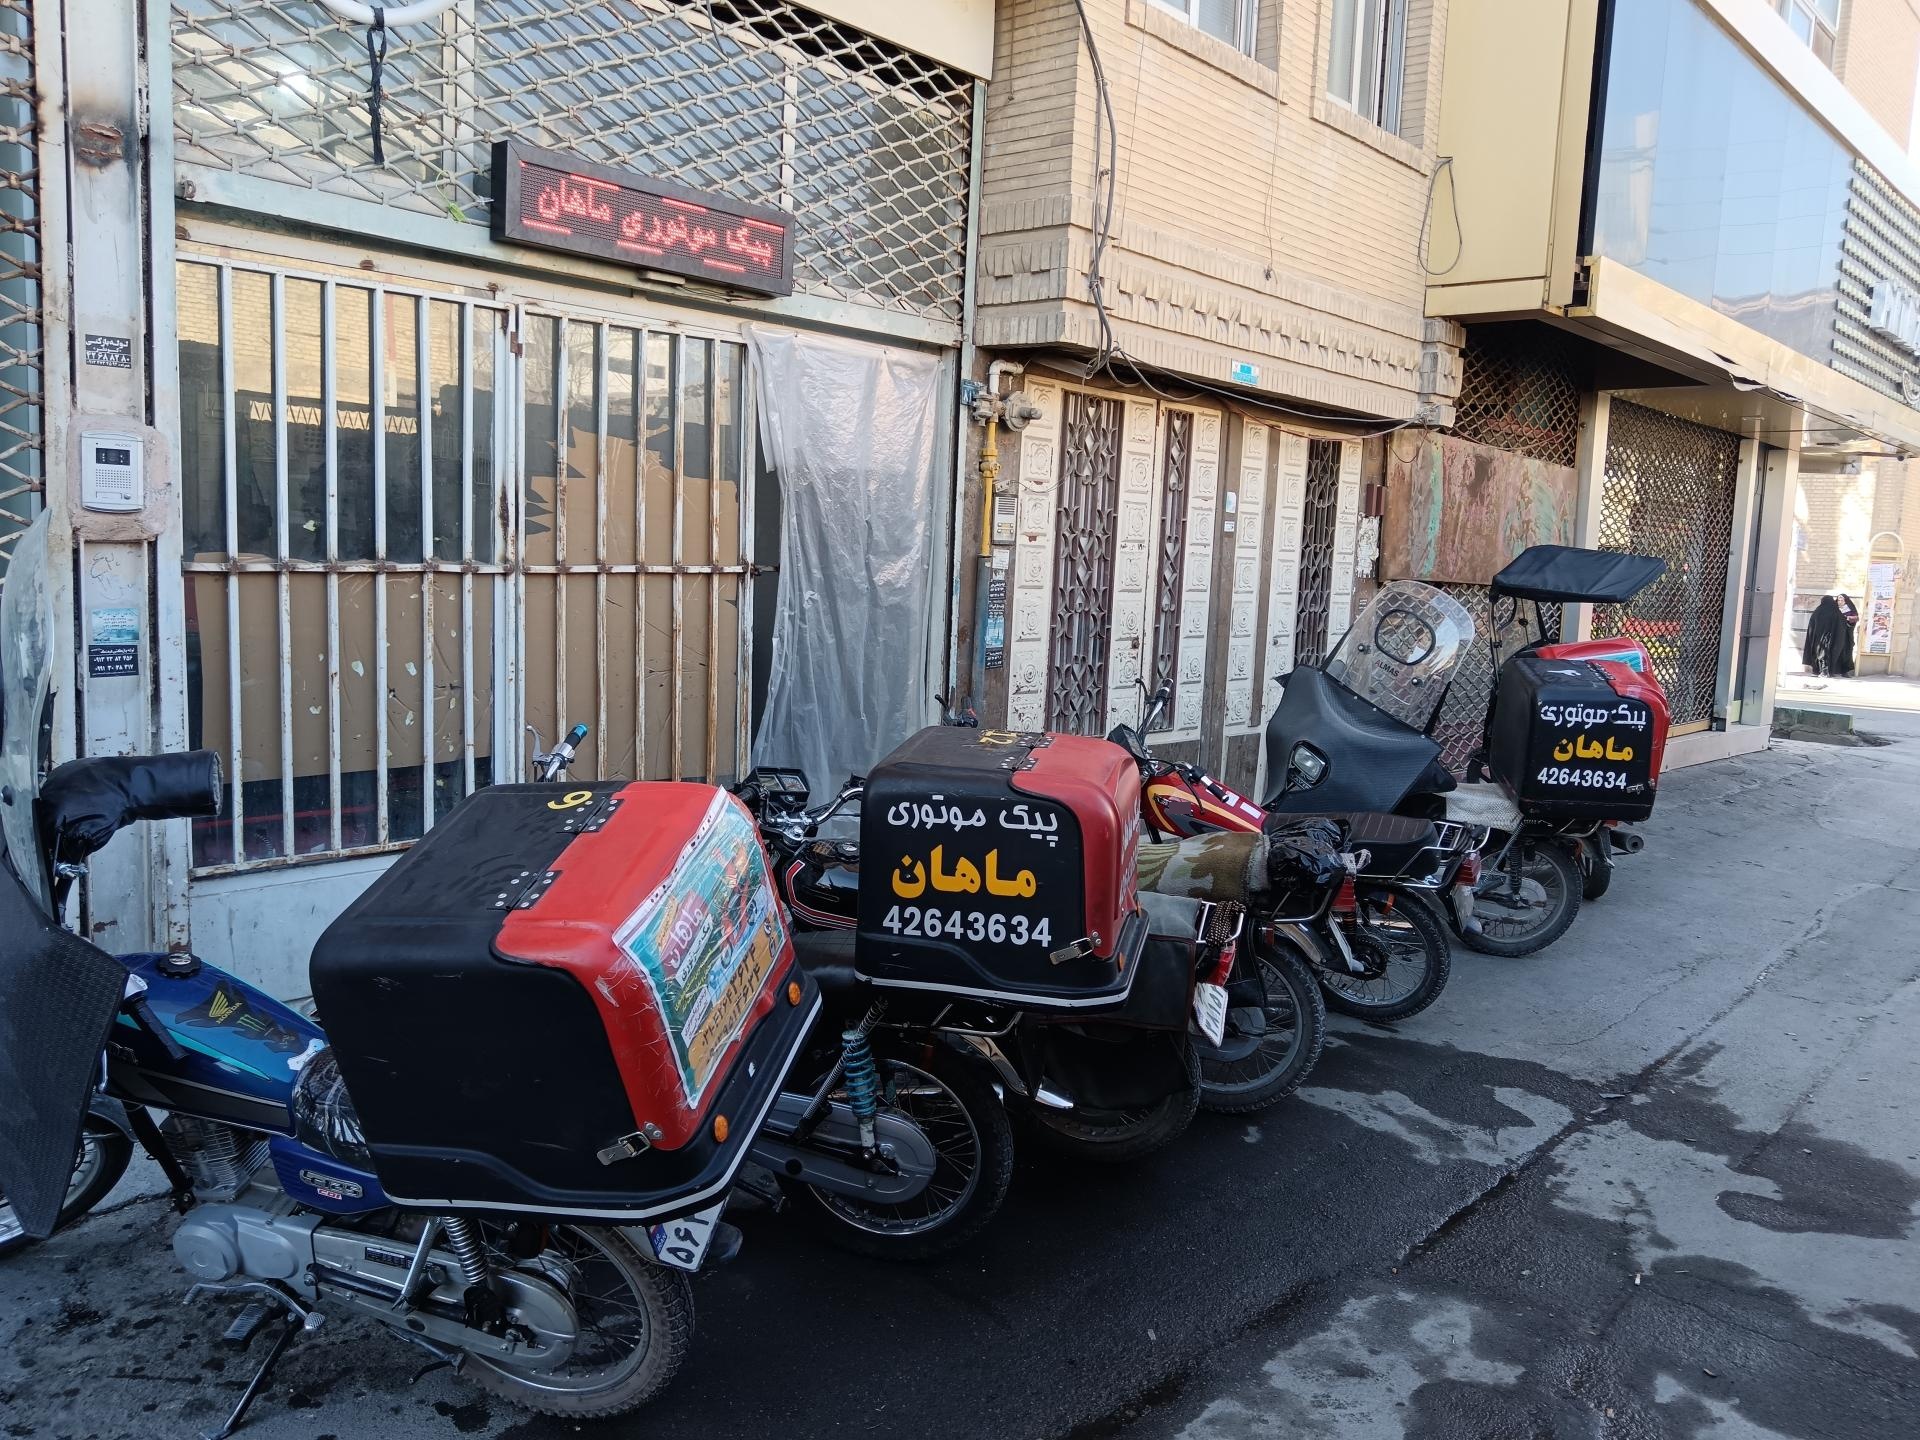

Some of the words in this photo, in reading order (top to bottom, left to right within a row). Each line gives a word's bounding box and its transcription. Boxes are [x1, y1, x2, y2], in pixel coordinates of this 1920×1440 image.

[537, 178, 612, 221] ماهان
[621, 211, 717, 253] موتوری
[725, 226, 772, 267] پیک
[1374, 659, 1400, 677] ALMAS
[1538, 700, 1609, 730] موتوری
[1610, 704, 1647, 732] پیک
[1553, 734, 1634, 762] ماهان
[1537, 767, 1627, 790] 42643634
[887, 794, 987, 833] موتوری
[999, 802, 1058, 848] پیک
[892, 844, 1038, 899] ماهان
[882, 905, 1052, 948] 42643634
[215, 1002, 244, 1025] HONDA
